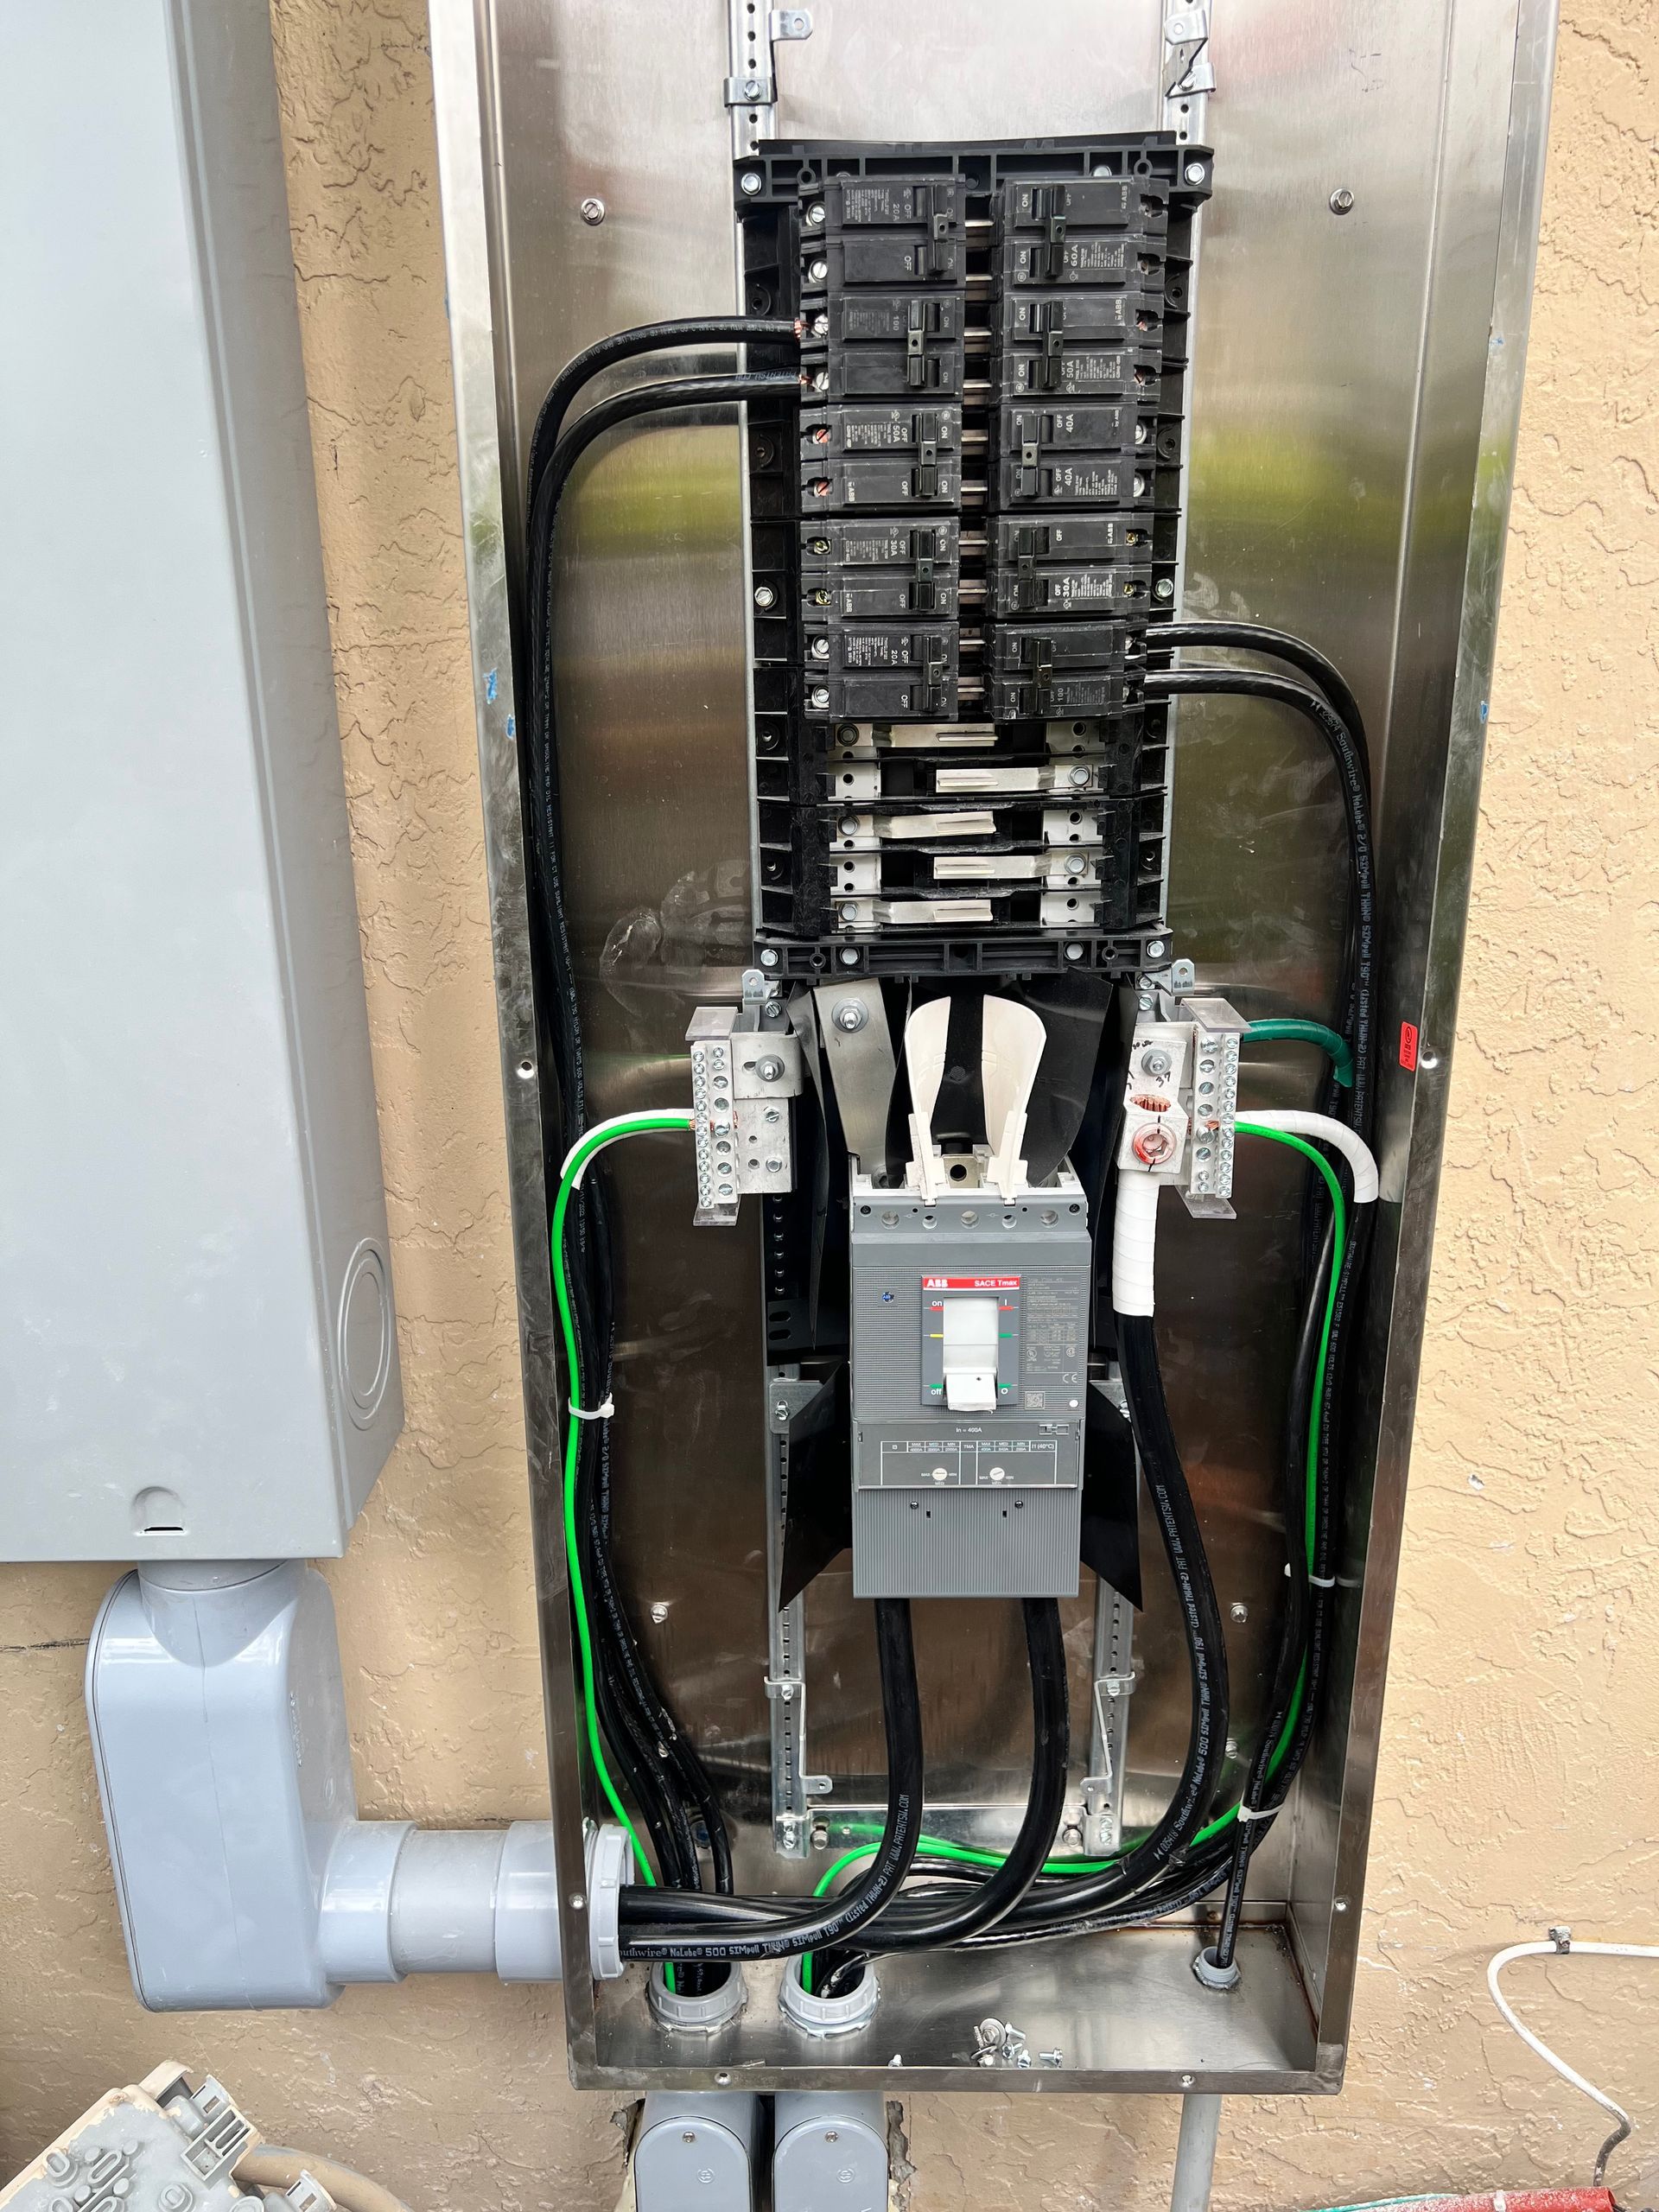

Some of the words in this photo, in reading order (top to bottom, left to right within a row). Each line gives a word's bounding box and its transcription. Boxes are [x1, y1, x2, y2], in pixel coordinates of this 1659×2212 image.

[1021, 194, 1028, 207] ON
[947, 258, 953, 270] ON
[1020, 251, 1027, 264] ON
[1019, 307, 1026, 321] ON
[944, 316, 950, 327] ON
[1018, 364, 1025, 377] ON
[942, 372, 949, 383] ON
[1015, 415, 1022, 426] ON
[941, 426, 948, 439] ON
[1015, 468, 1022, 480] ON
[941, 480, 948, 493] ON
[939, 539, 946, 551] ON
[940, 592, 947, 605] ON
[1012, 642, 1018, 653] ON
[940, 696, 947, 708] ON
[1010, 692, 1016, 702] ON
[1357, 834, 1367, 853] 2/0
[1356, 1056, 1367, 1071] PAT
[927, 1279, 948, 1287] ABB
[1175, 1556, 1188, 1570] PAT
[1198, 1736, 1209, 1756] 500
[705, 1947, 726, 1957] 500
[728, 1944, 760, 1955] SIMpull
[792, 1931, 823, 1947] SIMpull
[845, 1900, 868, 1923] (Listed
[882, 1859, 896, 1877] PAT
